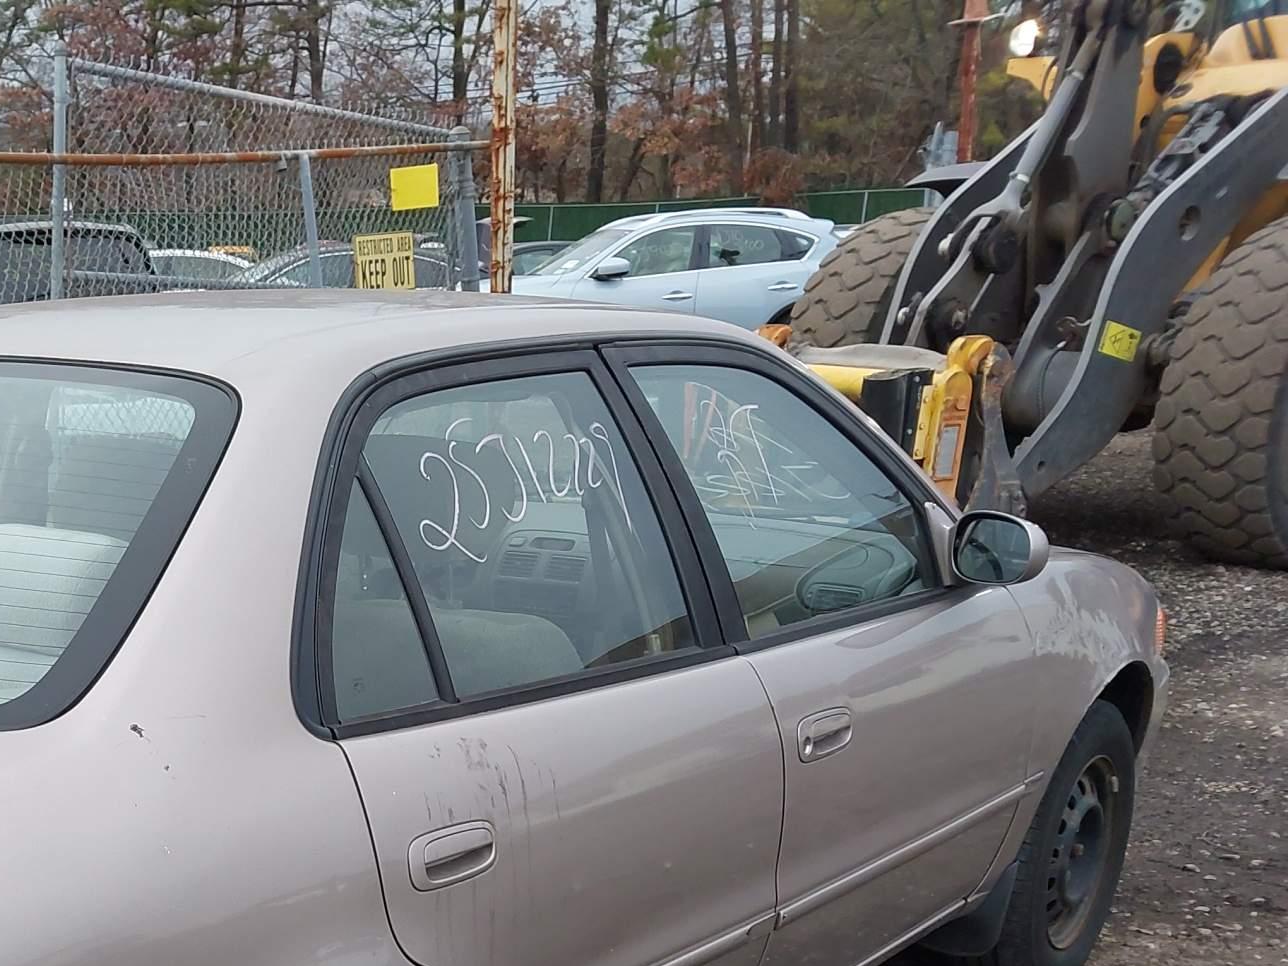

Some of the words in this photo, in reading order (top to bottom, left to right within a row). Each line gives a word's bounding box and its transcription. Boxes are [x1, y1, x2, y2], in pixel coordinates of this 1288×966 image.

[358, 237, 393, 256] RESTRICTED
[397, 236, 411, 252] AREA
[361, 258, 387, 289] KEEP
[392, 255, 411, 287] OUT
